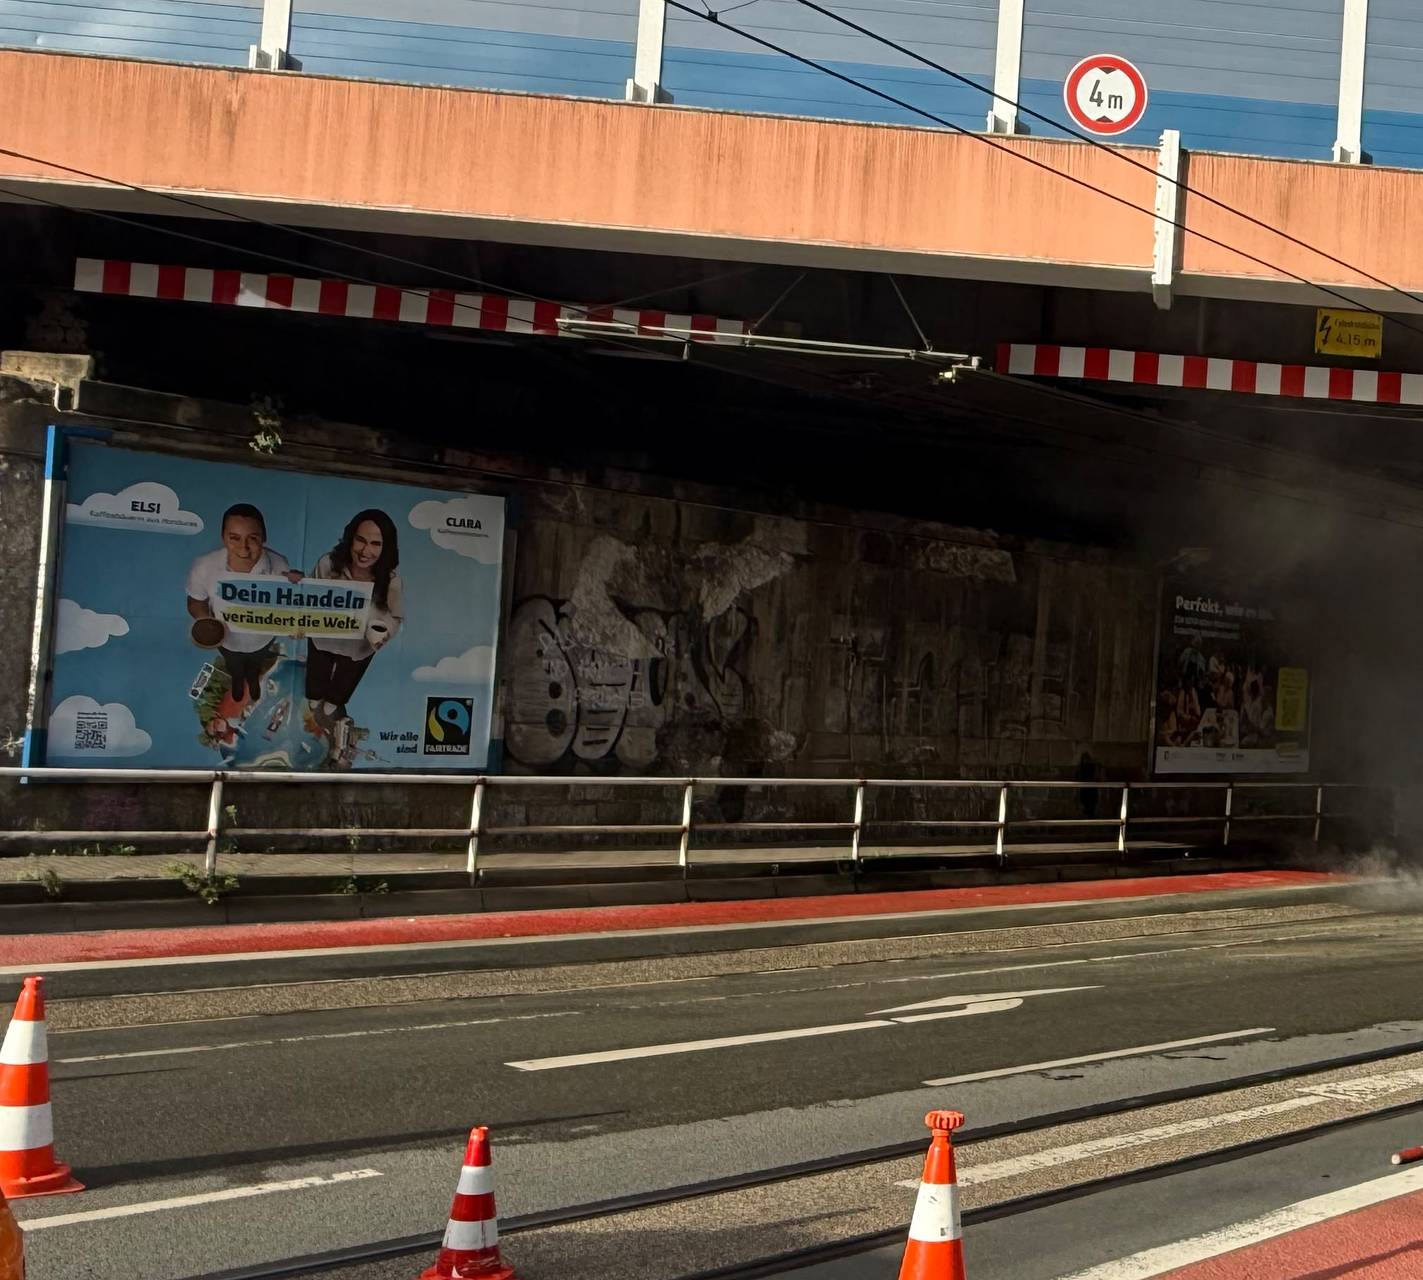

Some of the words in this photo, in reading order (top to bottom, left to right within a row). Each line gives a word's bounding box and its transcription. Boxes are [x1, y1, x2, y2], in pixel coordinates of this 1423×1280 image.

[1089, 79, 1104, 107] 4
[1108, 94, 1123, 110] m
[130, 500, 161, 514] ELSI
[446, 517, 482, 530] CLARA
[221, 582, 271, 604] Dein
[276, 587, 365, 609] Handeln
[222, 611, 295, 627] verändert
[298, 615, 320, 627] die
[323, 616, 359, 630] Welt.
[379, 731, 398, 741] Wir
[399, 731, 419, 741] alle
[396, 743, 418, 754] sind
[425, 744, 468, 753] FAIRTRADE
